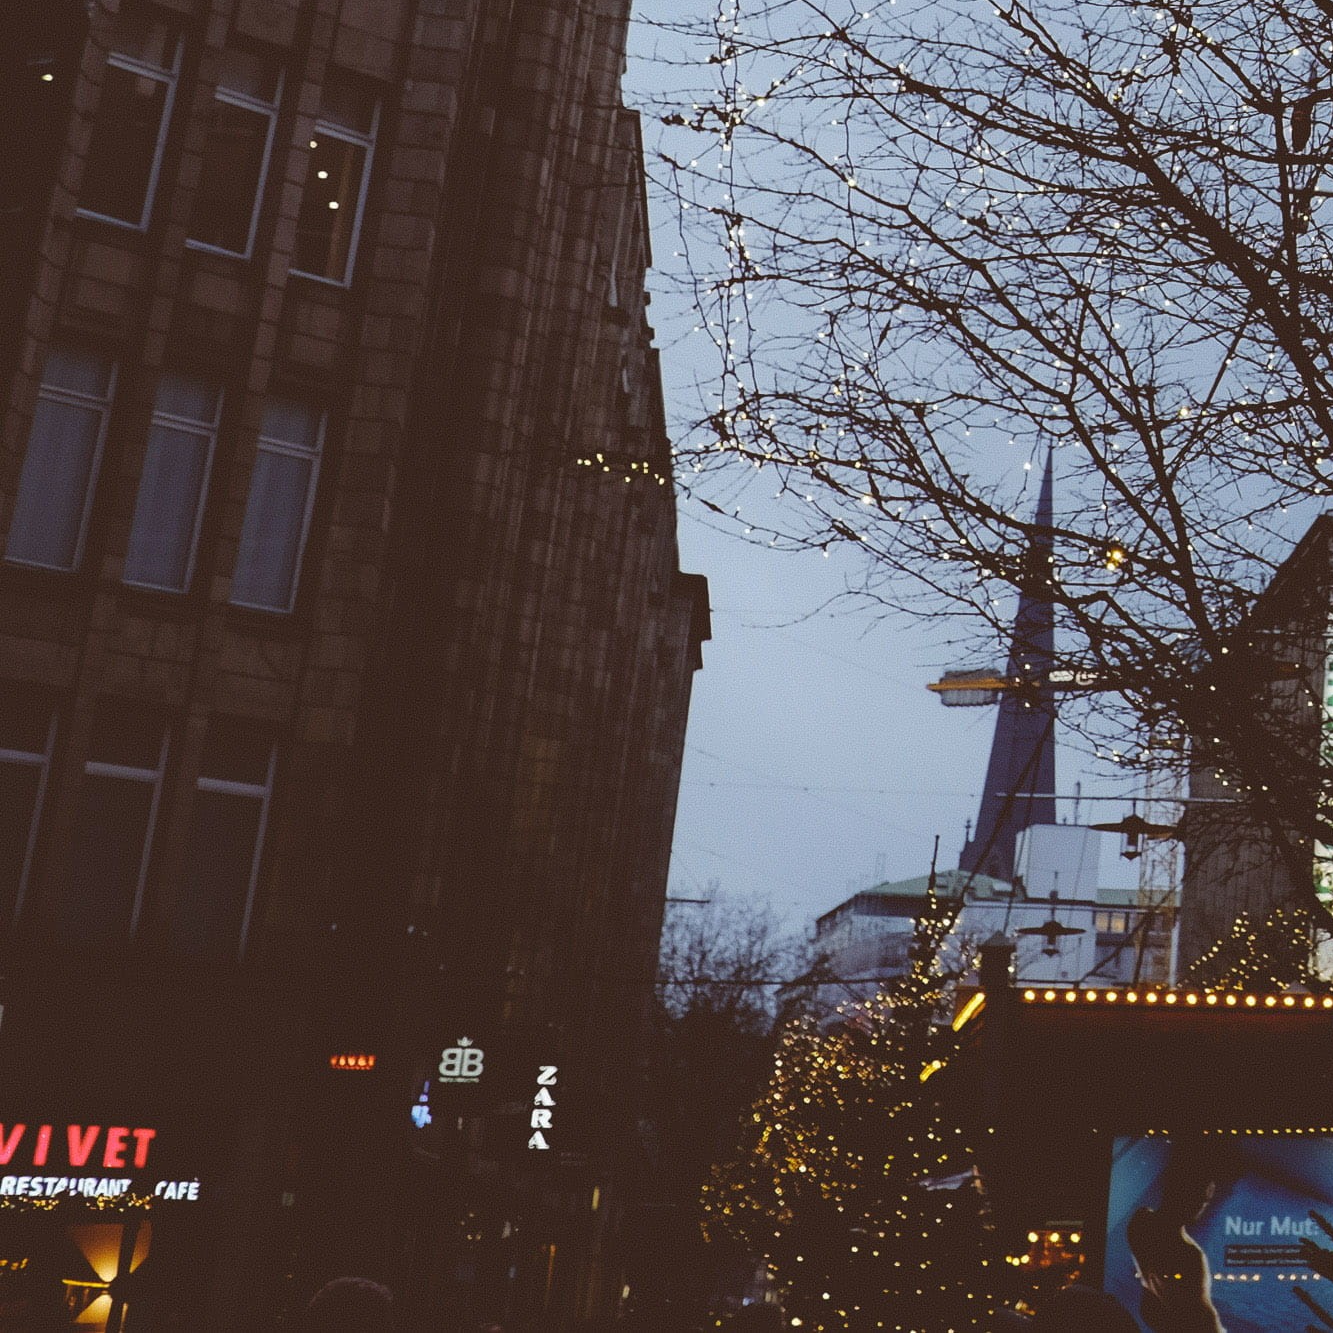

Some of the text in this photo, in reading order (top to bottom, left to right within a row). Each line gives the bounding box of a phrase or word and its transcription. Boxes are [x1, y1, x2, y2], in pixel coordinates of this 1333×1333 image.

[528, 1065, 558, 1150] ZARA
[0, 1123, 157, 1168] VIVET
[1225, 1216, 1265, 1236] Nur
